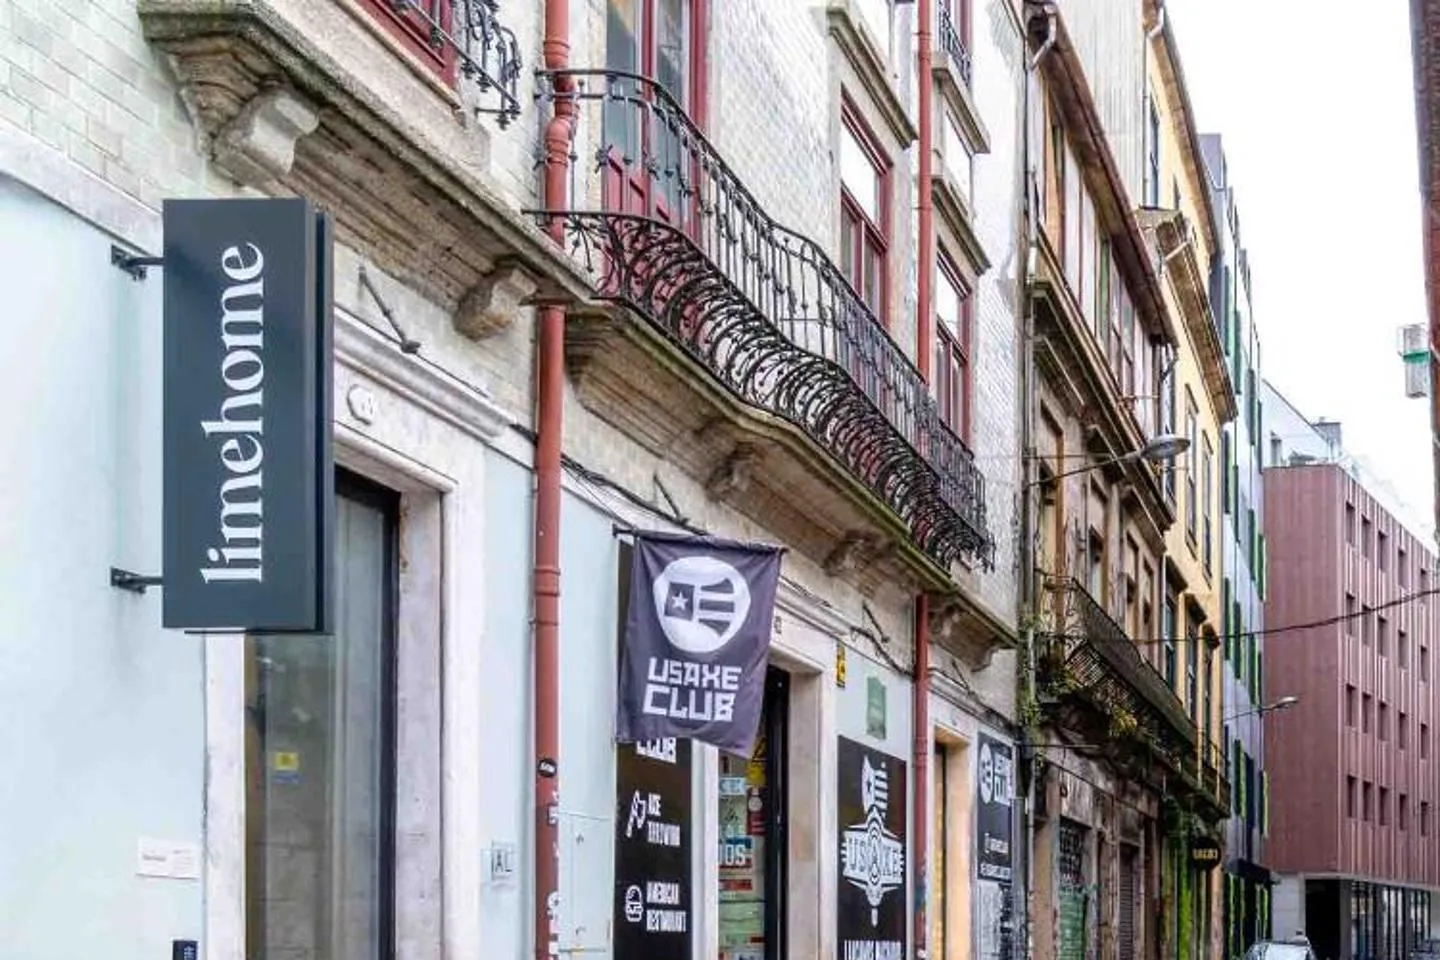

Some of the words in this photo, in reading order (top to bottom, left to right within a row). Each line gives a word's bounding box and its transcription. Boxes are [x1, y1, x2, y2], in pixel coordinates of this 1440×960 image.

[200, 242, 264, 584] limehome
[648, 656, 742, 690] USAXE
[642, 683, 736, 722] CLUB
